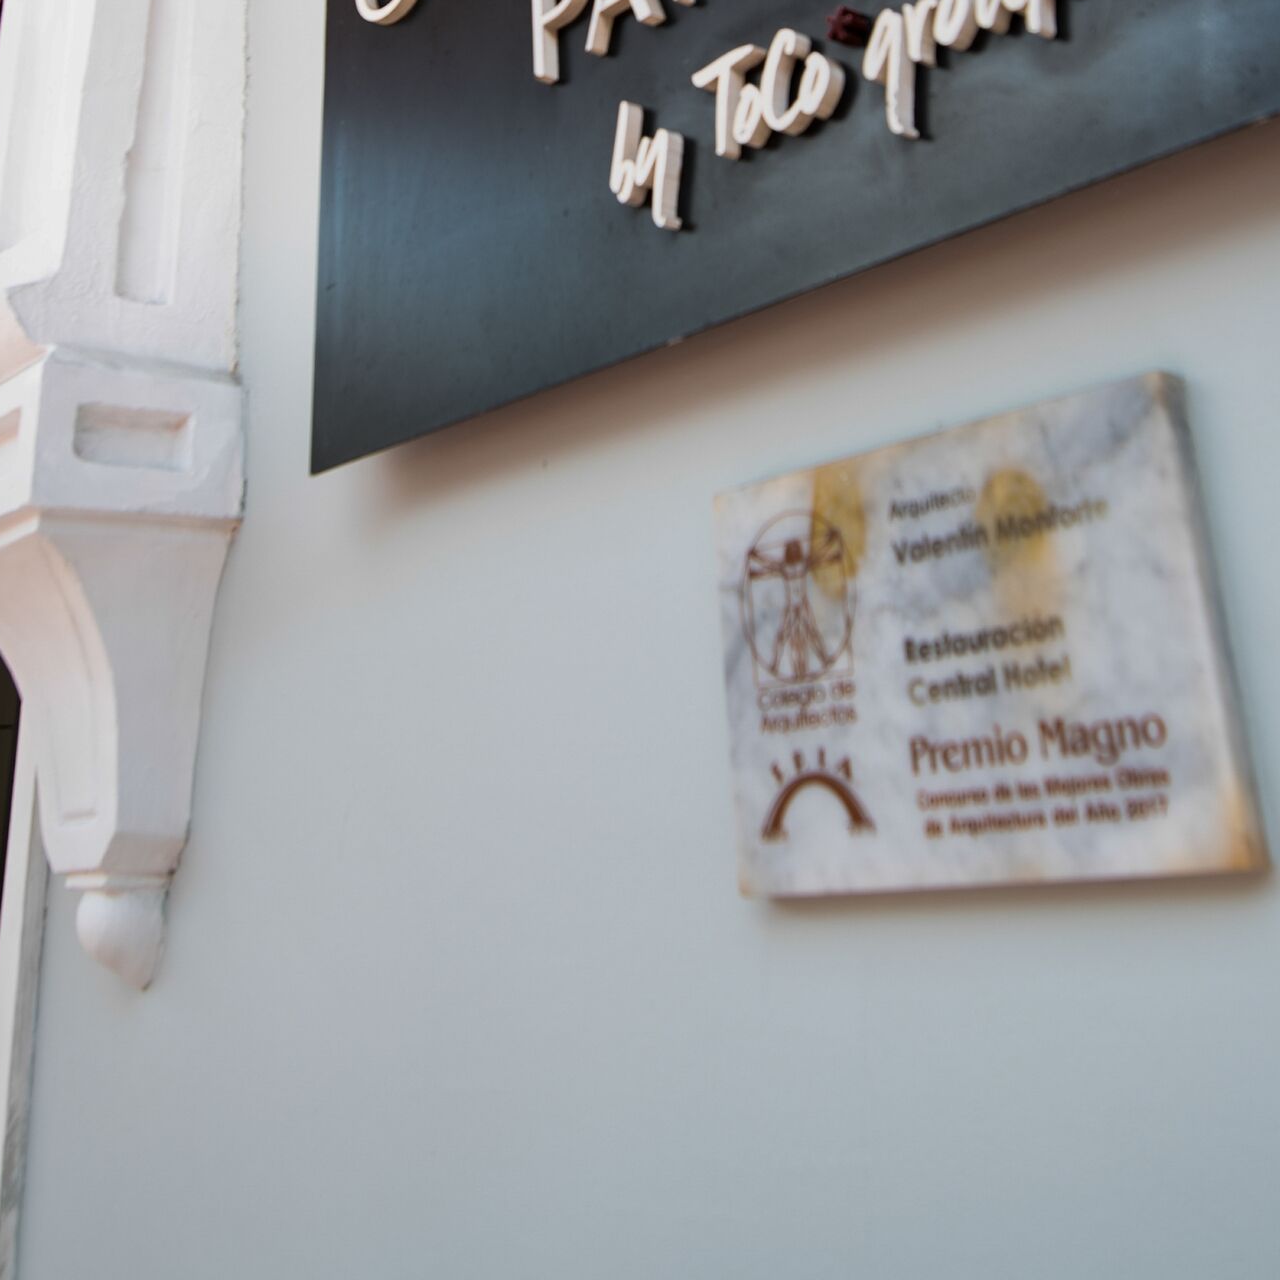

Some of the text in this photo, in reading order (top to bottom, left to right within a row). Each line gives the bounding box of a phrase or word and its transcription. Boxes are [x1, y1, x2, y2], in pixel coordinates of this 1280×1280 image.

[609, 101, 684, 231] by
[907, 654, 1072, 708] Central Hotel
[909, 711, 1168, 777] Premio Magno
